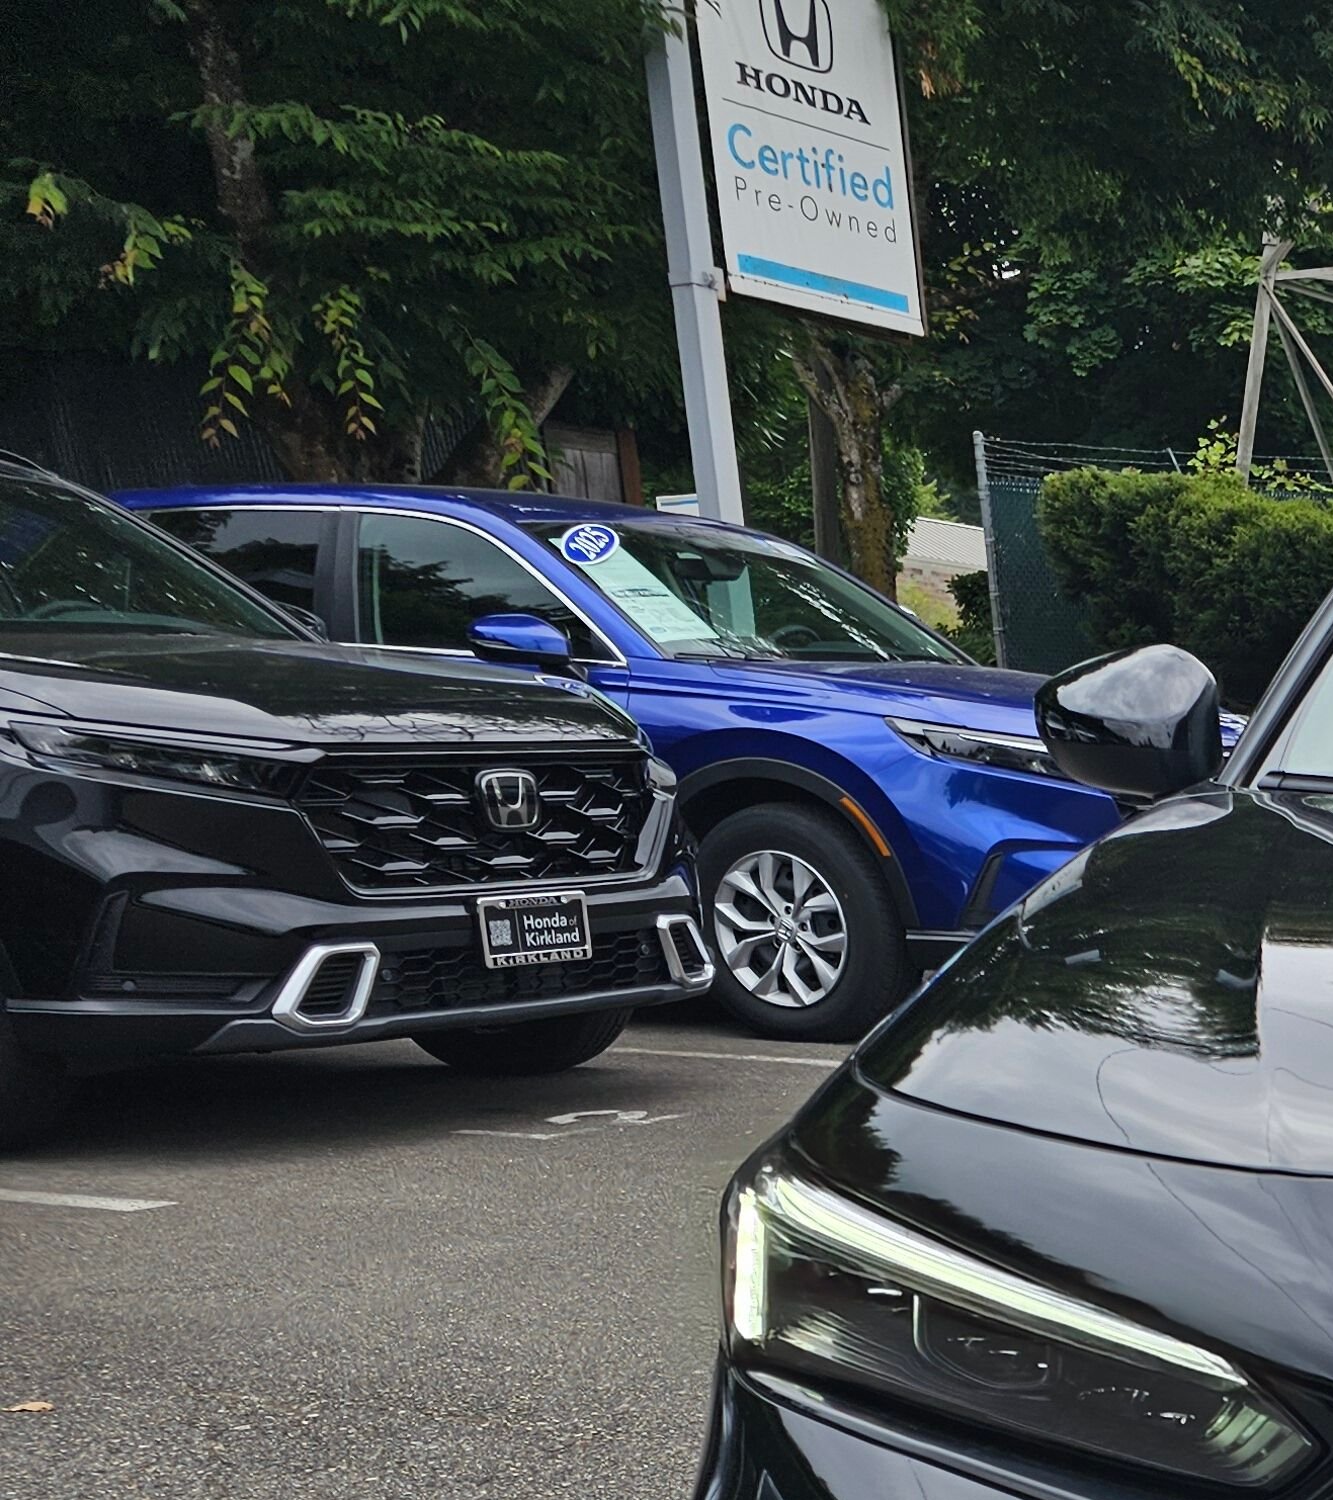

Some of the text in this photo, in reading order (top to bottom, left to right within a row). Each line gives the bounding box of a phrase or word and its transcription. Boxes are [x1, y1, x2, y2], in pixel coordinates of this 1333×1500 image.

[735, 61, 871, 125] HONDA
[727, 122, 894, 210] Certified
[735, 176, 897, 243] Pre-Owned
[568, 527, 610, 561] 2025
[508, 896, 558, 908] HONDA
[523, 912, 578, 930] Honda of
[525, 927, 580, 947] Kirkland
[497, 950, 583, 966] KIRKLAND
